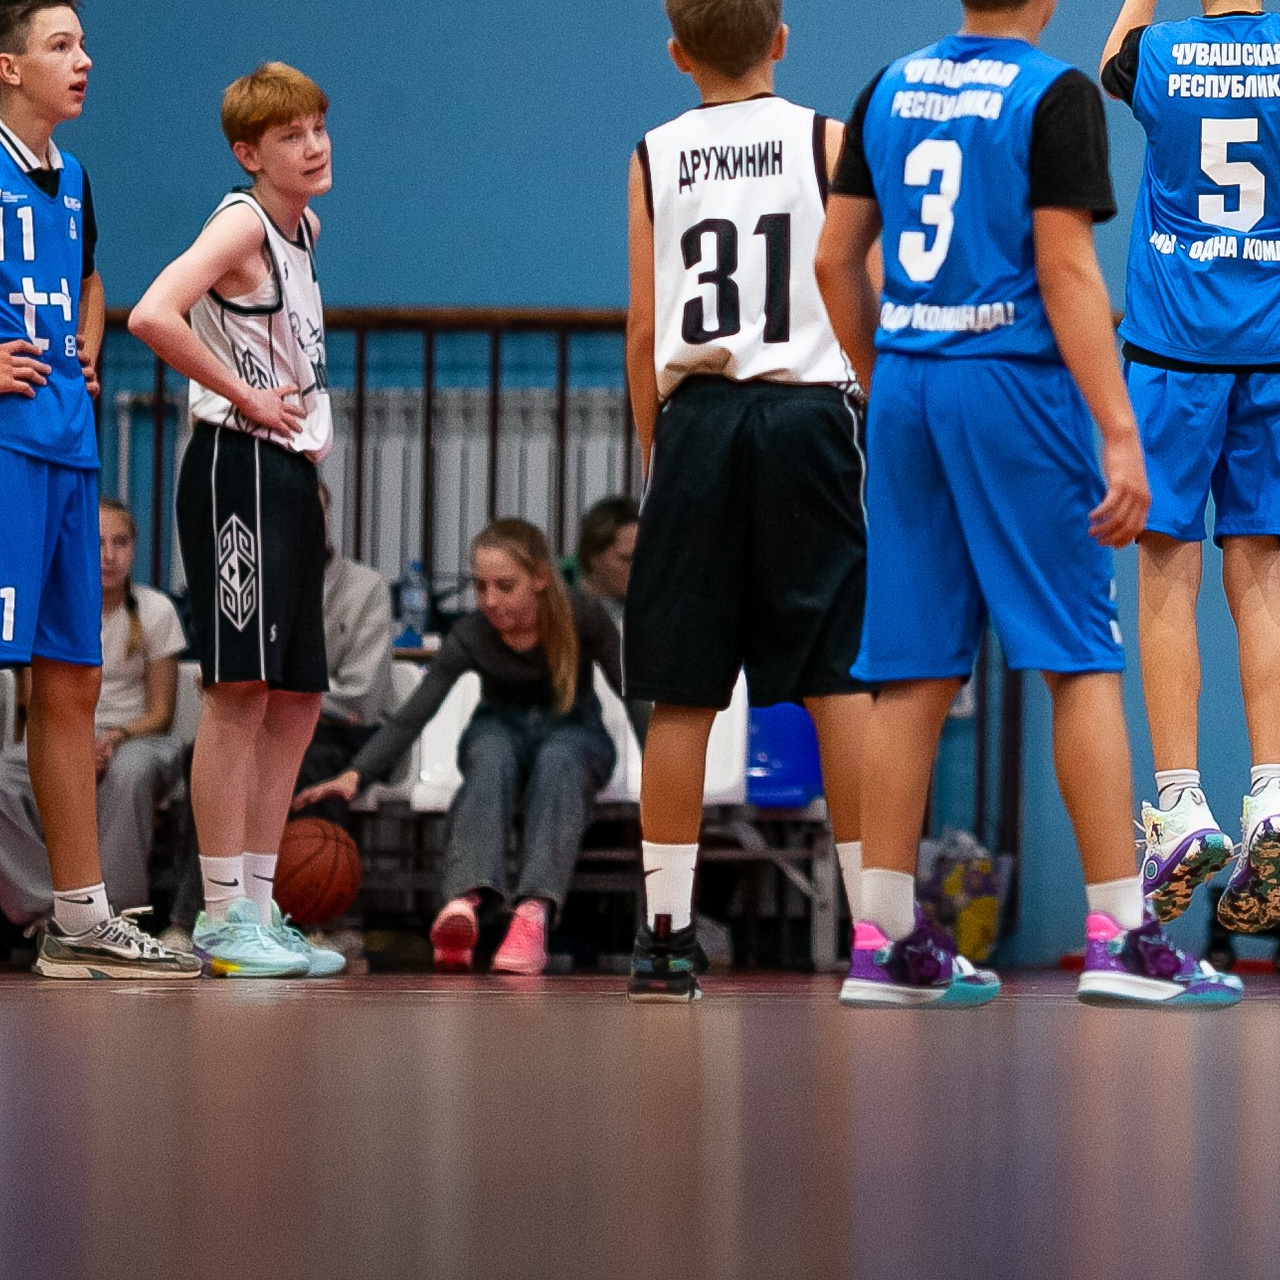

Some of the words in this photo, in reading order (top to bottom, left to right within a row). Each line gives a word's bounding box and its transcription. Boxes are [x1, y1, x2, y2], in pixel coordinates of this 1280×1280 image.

[678, 140, 783, 194] ДРУЖИНИН
[897, 138, 962, 282] 3
[1198, 117, 1265, 233] 5
[0, 205, 36, 261] 1
[1188, 235, 1238, 262] ОДНА
[680, 212, 791, 344] 31
